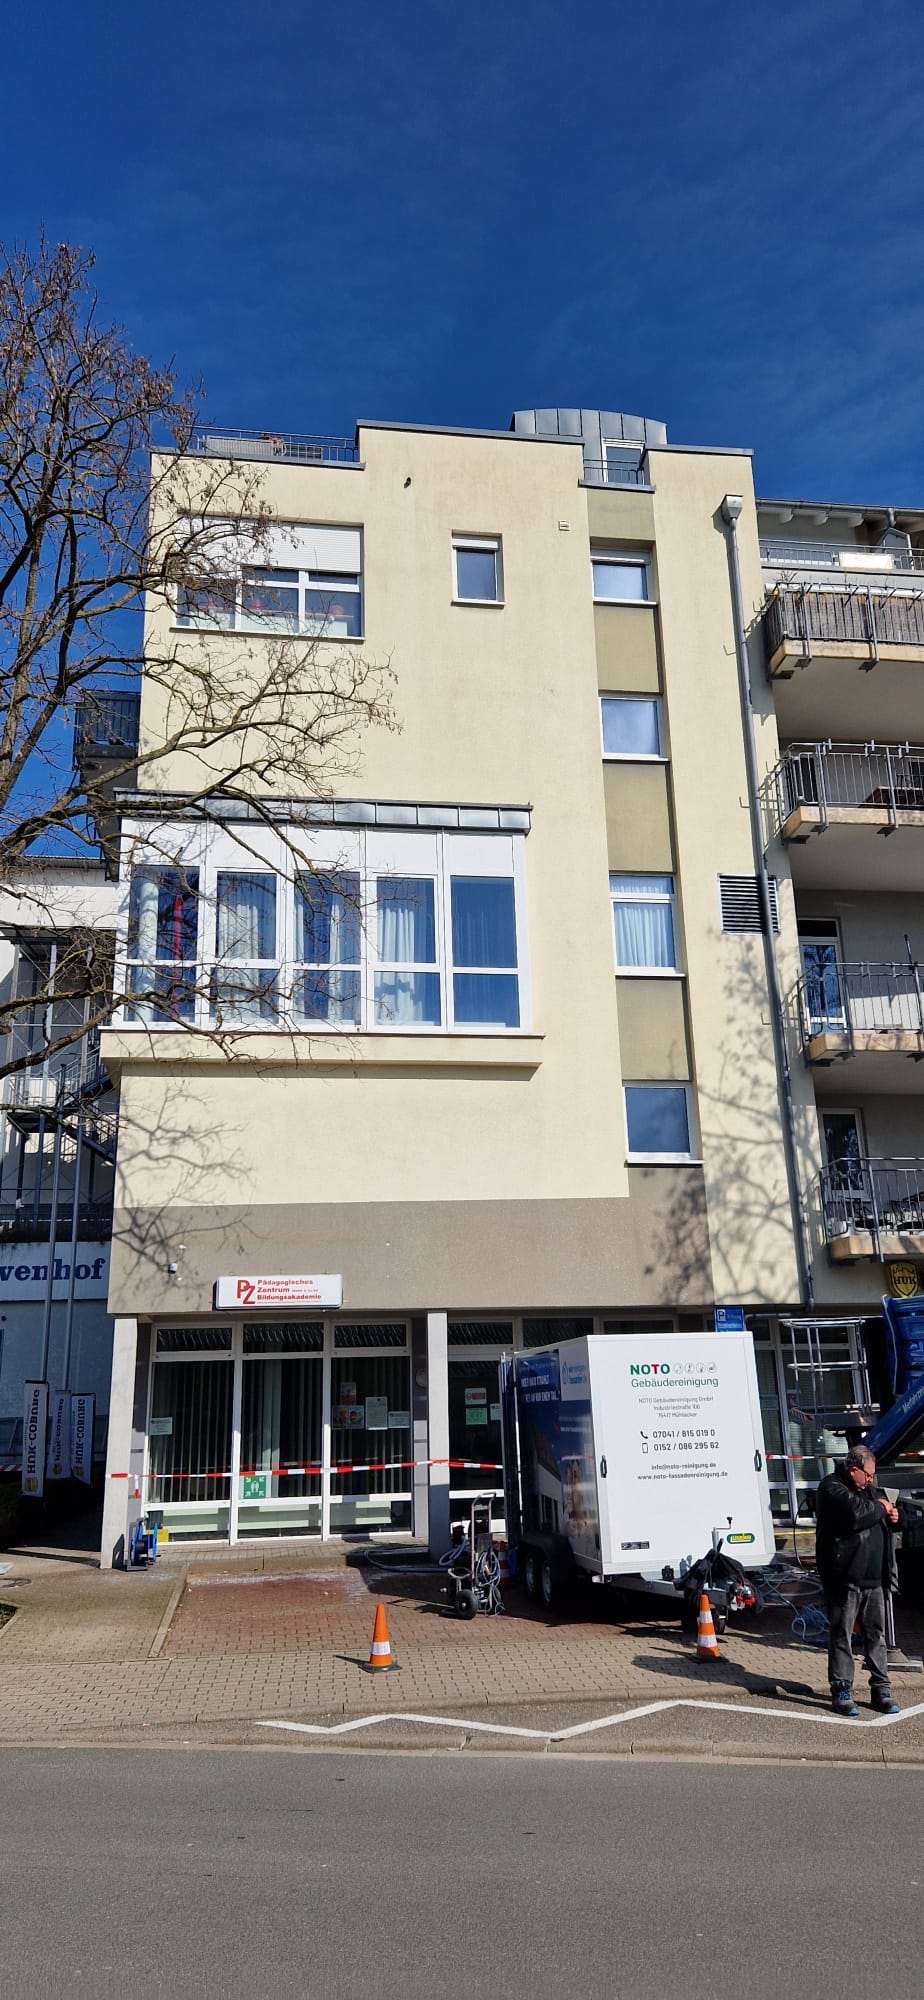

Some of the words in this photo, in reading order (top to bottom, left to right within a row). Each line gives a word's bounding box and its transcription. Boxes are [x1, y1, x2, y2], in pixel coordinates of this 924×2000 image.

[257, 1279, 314, 1287] Pädagogisches
[894, 1276, 917, 1285] HUK
[256, 1293, 322, 1301] Bildungsakademie
[630, 1363, 671, 1375] NOTO
[631, 1377, 719, 1388] Gebäudereinigung
[652, 1430, 675, 1439] 07041
[681, 1429, 695, 1438] 815
[696, 1429, 709, 1437] 019
[710, 1429, 716, 1437] 0
[653, 1443, 672, 1451] 0152
[678, 1442, 693, 1450] 086
[694, 1442, 709, 1450] 295
[710, 1441, 720, 1449] 62
[651, 1462, 717, 1471] info@noto-reinigung.de
[637, 1471, 728, 1480] www.noto-fassadenreinigung.de
